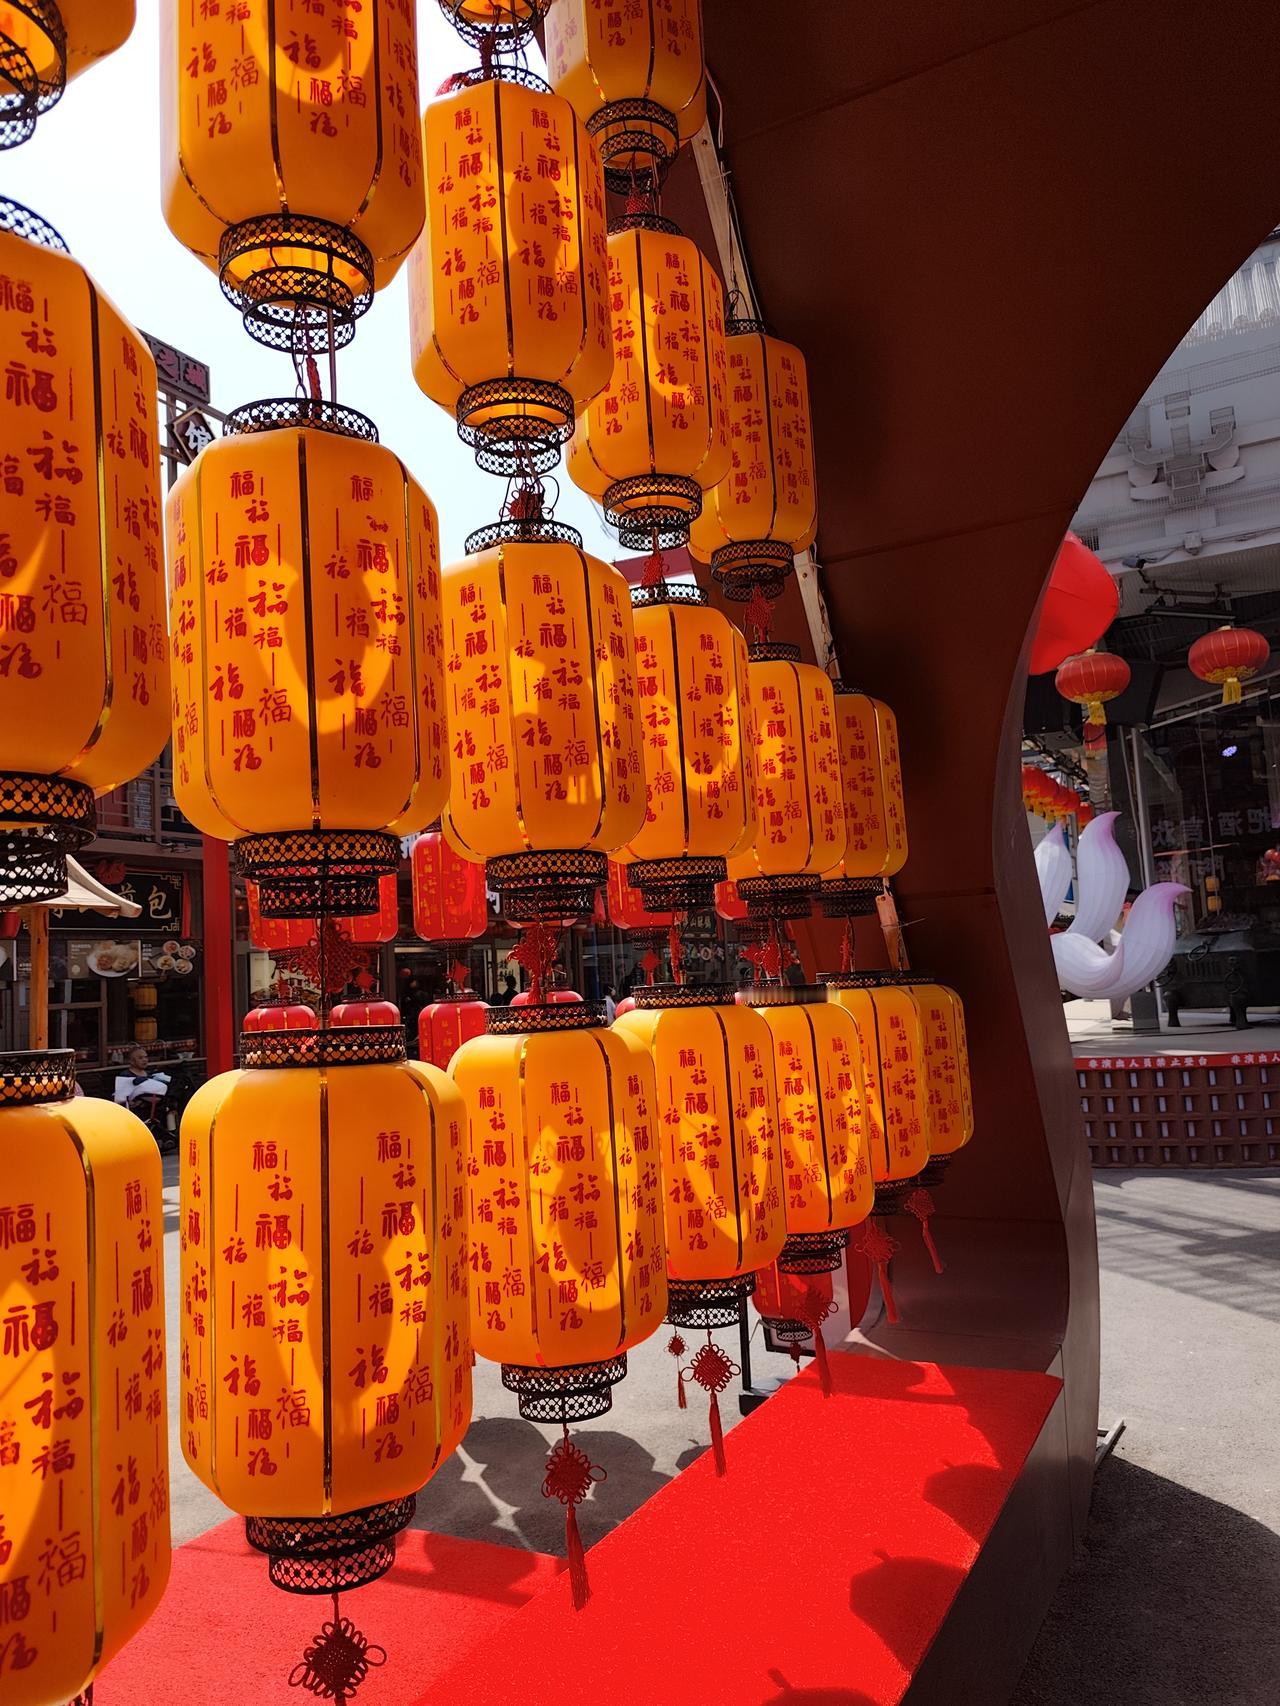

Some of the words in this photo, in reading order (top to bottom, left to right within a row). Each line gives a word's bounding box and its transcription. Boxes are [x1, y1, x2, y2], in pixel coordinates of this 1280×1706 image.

[226, 3, 250, 23] 福
[332, 17, 357, 39] 福
[187, 43, 216, 77] 福
[282, 31, 321, 68] 福
[231, 56, 258, 91] 福
[208, 80, 227, 106] 福
[310, 78, 332, 107] 福
[337, 70, 366, 108] 福
[209, 112, 231, 138] 福
[310, 112, 337, 137] 福
[455, 107, 471, 130] 福
[532, 109, 549, 129] 福
[459, 153, 482, 178] 福
[537, 155, 560, 180] 福
[452, 208, 467, 229] 福
[531, 203, 547, 225] 福
[548, 192, 573, 220] 福
[473, 218, 492, 234] 福
[442, 248, 465, 276] 福
[519, 241, 545, 268] 福
[459, 277, 474, 298] 福
[477, 261, 499, 288] 福
[675, 272, 689, 286] 福
[460, 304, 479, 324] 福
[538, 301, 557, 321] 福
[653, 301, 666, 315] 福
[670, 291, 689, 311] 福
[21, 322, 56, 357] 福
[679, 321, 700, 343] 福
[616, 346, 632, 360] 福
[683, 348, 698, 362] 福
[5, 361, 57, 412] 福
[656, 363, 678, 385] 福
[672, 393, 685, 409] 福
[687, 385, 705, 405] 福
[734, 386, 752, 403] 福
[672, 413, 688, 429] 福
[129, 418, 149, 468] 福
[26, 430, 83, 485] 福
[230, 471, 254, 499] 福
[351, 475, 373, 502] 福
[35, 493, 75, 526] 福
[245, 499, 269, 523] 福
[235, 535, 269, 568] 福
[357, 539, 388, 573] 福
[113, 564, 139, 612] 福
[532, 575, 552, 595] 福
[42, 574, 87, 625] 福
[248, 580, 288, 617] 福
[546, 597, 565, 615] 福
[225, 608, 247, 639] 福
[346, 608, 369, 638] 福
[539, 623, 567, 648] 福
[254, 627, 282, 648] 福
[465, 630, 487, 657] 福
[552, 658, 582, 686] 福
[642, 654, 657, 669] 福
[209, 663, 243, 701] 福
[328, 659, 363, 697] 福
[476, 665, 501, 692] 福
[637, 677, 657, 697] 福
[705, 674, 723, 695] 福
[260, 688, 291, 723] 福
[381, 693, 409, 728] 福
[481, 699, 499, 717] 福
[558, 694, 580, 710] 福
[233, 709, 255, 738] 福
[356, 708, 377, 736] 福
[646, 705, 669, 728] 福
[768, 720, 786, 737] 福
[454, 730, 475, 758] 福
[522, 719, 551, 747] 福
[650, 734, 667, 748] 福
[234, 744, 262, 772] 福
[354, 743, 381, 768] 福
[487, 745, 508, 773] 福
[544, 754, 563, 775] 福
[565, 740, 589, 767] 福
[692, 752, 713, 774] 福
[763, 759, 775, 773] 福
[777, 745, 797, 764] 福
[470, 762, 485, 784] 福
[654, 772, 674, 794] 福
[722, 769, 738, 792] 福
[781, 769, 795, 781] 福
[472, 789, 490, 810] 福
[545, 780, 567, 800] 福
[708, 803, 723, 819] 福
[679, 1050, 696, 1068] 福
[691, 1069, 707, 1085] 福
[479, 1087, 495, 1109] 福
[550, 1082, 570, 1105] 福
[685, 1093, 708, 1114] 福
[750, 1085, 765, 1108] 福
[664, 1108, 680, 1125] 福
[795, 1104, 816, 1123] 福
[377, 1131, 401, 1163] 福
[557, 1135, 585, 1163] 福
[696, 1124, 721, 1148] 福
[253, 1141, 277, 1172] 福
[483, 1140, 506, 1167] 福
[679, 1143, 695, 1162] 福
[701, 1154, 719, 1169] 福
[125, 1180, 142, 1219] 福
[268, 1174, 292, 1201] 福
[569, 1175, 600, 1204] 福
[670, 1178, 694, 1203] 福
[382, 1201, 415, 1239] 福
[575, 1211, 597, 1230] 福
[706, 1196, 726, 1219] 福
[0, 1204, 35, 1249] 福
[256, 1214, 291, 1250] 福
[498, 1217, 517, 1235] 福
[347, 1229, 374, 1258] 福
[689, 1233, 708, 1250] 福
[21, 1249, 59, 1285] 福
[469, 1243, 491, 1273] 福
[537, 1242, 568, 1273] 福
[395, 1252, 431, 1291] 福
[503, 1268, 524, 1298] 福
[581, 1261, 606, 1291] 福
[132, 1266, 153, 1317] 福
[369, 1282, 393, 1317] 福
[486, 1281, 501, 1305] 福
[559, 1280, 577, 1304] 福
[242, 1294, 265, 1328] 福
[400, 1301, 426, 1323] 福
[487, 1310, 505, 1331] 福
[560, 1308, 583, 1331] 福
[3, 1301, 58, 1358] 福
[108, 1309, 127, 1347] 福
[224, 1354, 260, 1396] 福
[349, 1344, 388, 1388] 福
[404, 1366, 433, 1404] 福
[24, 1372, 84, 1428] 福
[277, 1388, 310, 1427] 福
[377, 1393, 398, 1425] 福
[248, 1409, 272, 1440] 福
[32, 1439, 75, 1479] 福
[248, 1448, 277, 1476] 福
[39, 1531, 86, 1596] 福
